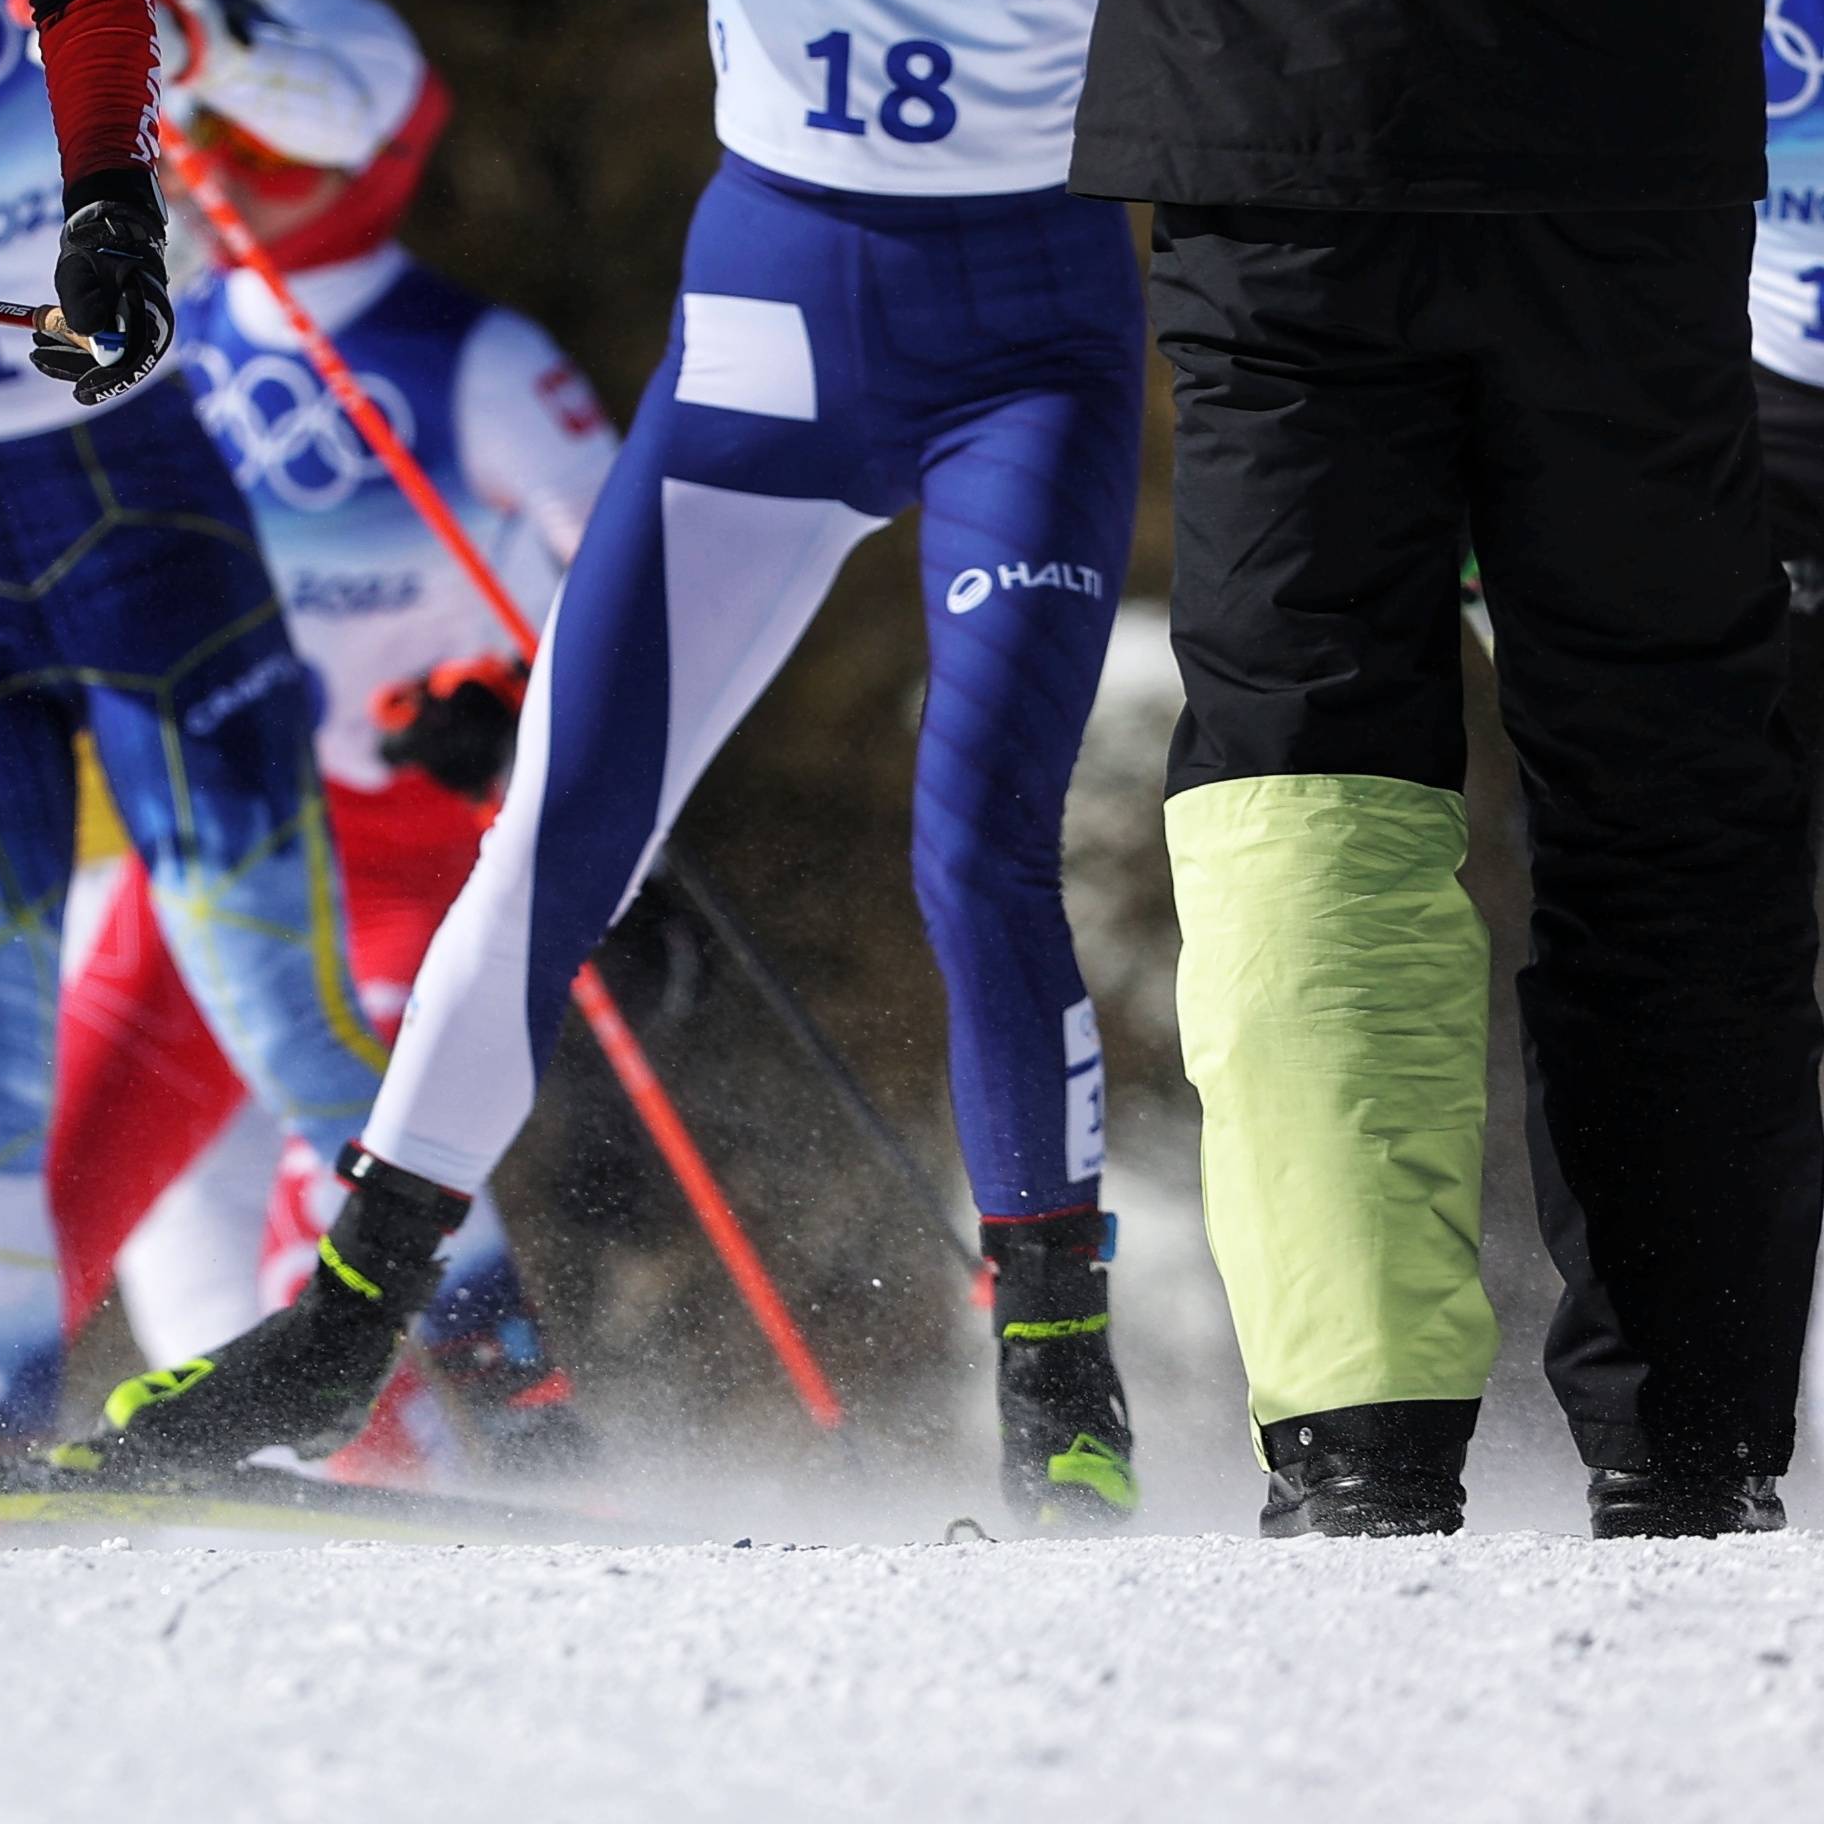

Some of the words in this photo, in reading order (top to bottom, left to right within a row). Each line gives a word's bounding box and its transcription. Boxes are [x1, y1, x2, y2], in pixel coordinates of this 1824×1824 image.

[804, 30, 958, 145] 18
[95, 354, 157, 403] AUCLAIR
[996, 561, 1103, 600] HALTI
